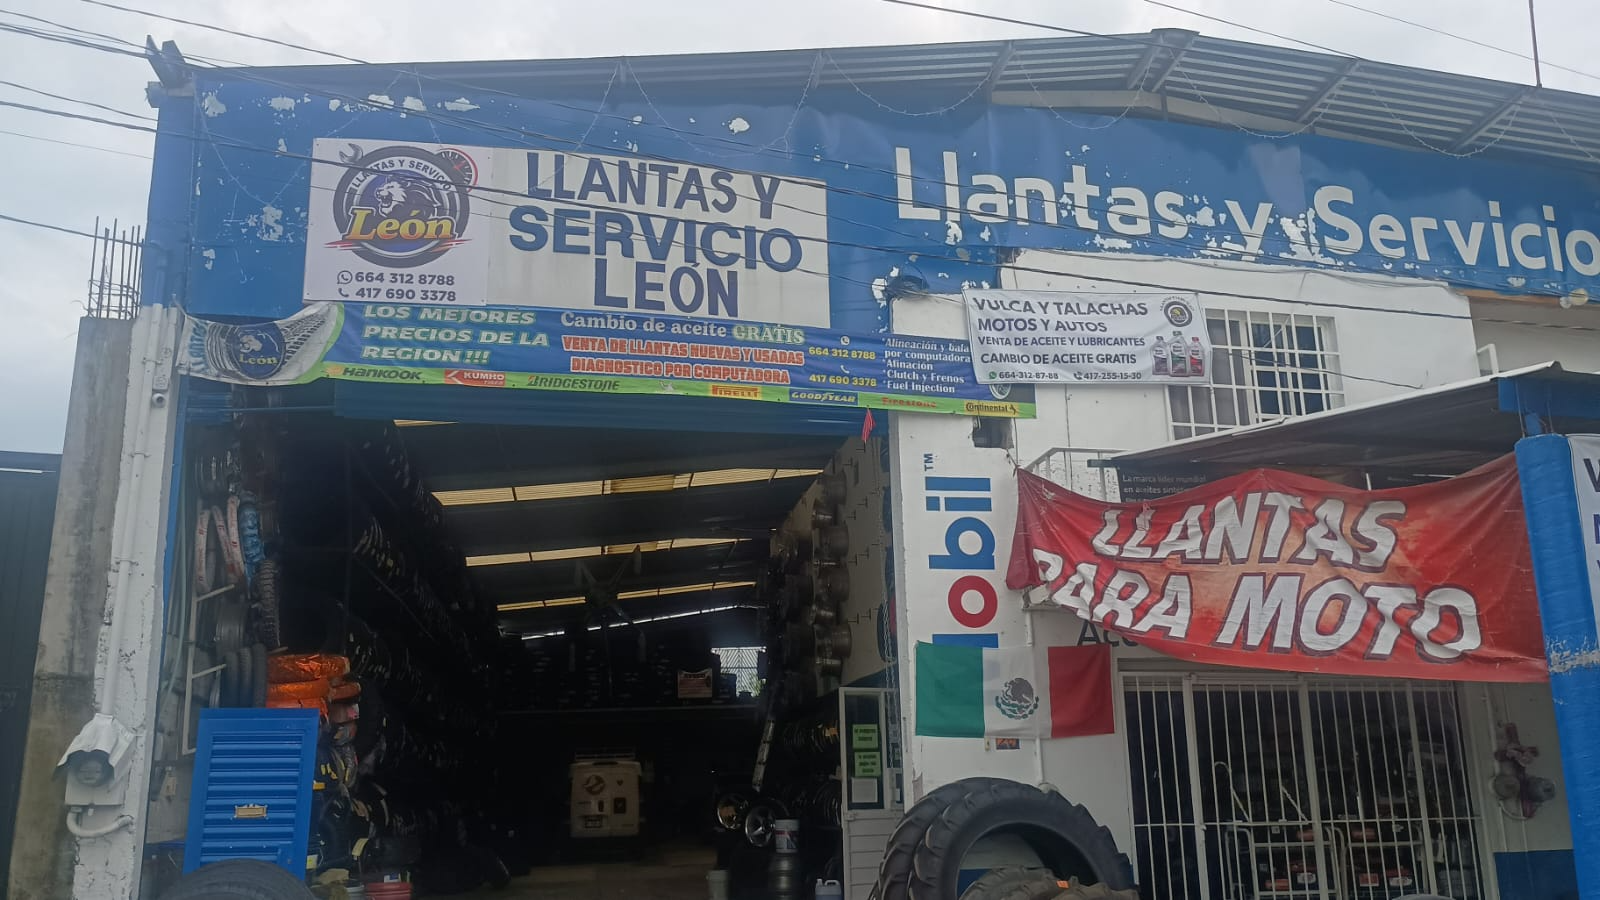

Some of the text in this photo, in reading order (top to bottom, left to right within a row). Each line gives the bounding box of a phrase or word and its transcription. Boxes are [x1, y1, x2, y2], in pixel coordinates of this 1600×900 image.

[398, 159, 406, 168] Y
[526, 152, 781, 219] LLANTAS Y
[894, 147, 1600, 276] Llantas y Servicio
[346, 209, 455, 240] León
[509, 204, 803, 273] SERVICIO
[355, 272, 455, 286] 664 312 8788
[355, 288, 456, 301] 417 690 3378
[593, 260, 739, 319] LEÓN
[973, 297, 1038, 314] VULCA
[1039, 299, 1050, 313] Y
[1053, 302, 1148, 316] TALACHAS
[364, 304, 536, 325] LOS MEJORES
[560, 311, 806, 345] Cambio de aceite GRATIS
[978, 318, 1108, 333] MOTOS Y AUTOS
[363, 324, 549, 346] PRECIOS DE LA
[978, 336, 1145, 347] VENTA DE ACEITE Y LUBRICANTES
[562, 335, 805, 366] VENTA DE LLANTAS NUEVAS Y USADAS
[808, 346, 876, 360] 664 312 8788
[940, 344, 946, 353] y
[239, 354, 278, 366] León
[884, 350, 971, 363] por computadora
[980, 353, 1137, 365] CAMBIO DE ACEITE GRATIS
[464, 371, 504, 381] KUMHO
[570, 356, 790, 384] DIAGNOSTICO POR COMPUTADORA
[887, 369, 965, 383] Clutch y Frenos
[998, 371, 1059, 380] 664-312-87-88
[1084, 372, 1142, 380] 417-255-15-30
[809, 374, 877, 387] 417 690 3378
[887, 380, 955, 393] Fuel Injection
[965, 402, 1008, 413] Continental
[1092, 491, 1407, 571] LLANTAS
[1032, 548, 1483, 661] PARA MOTO
